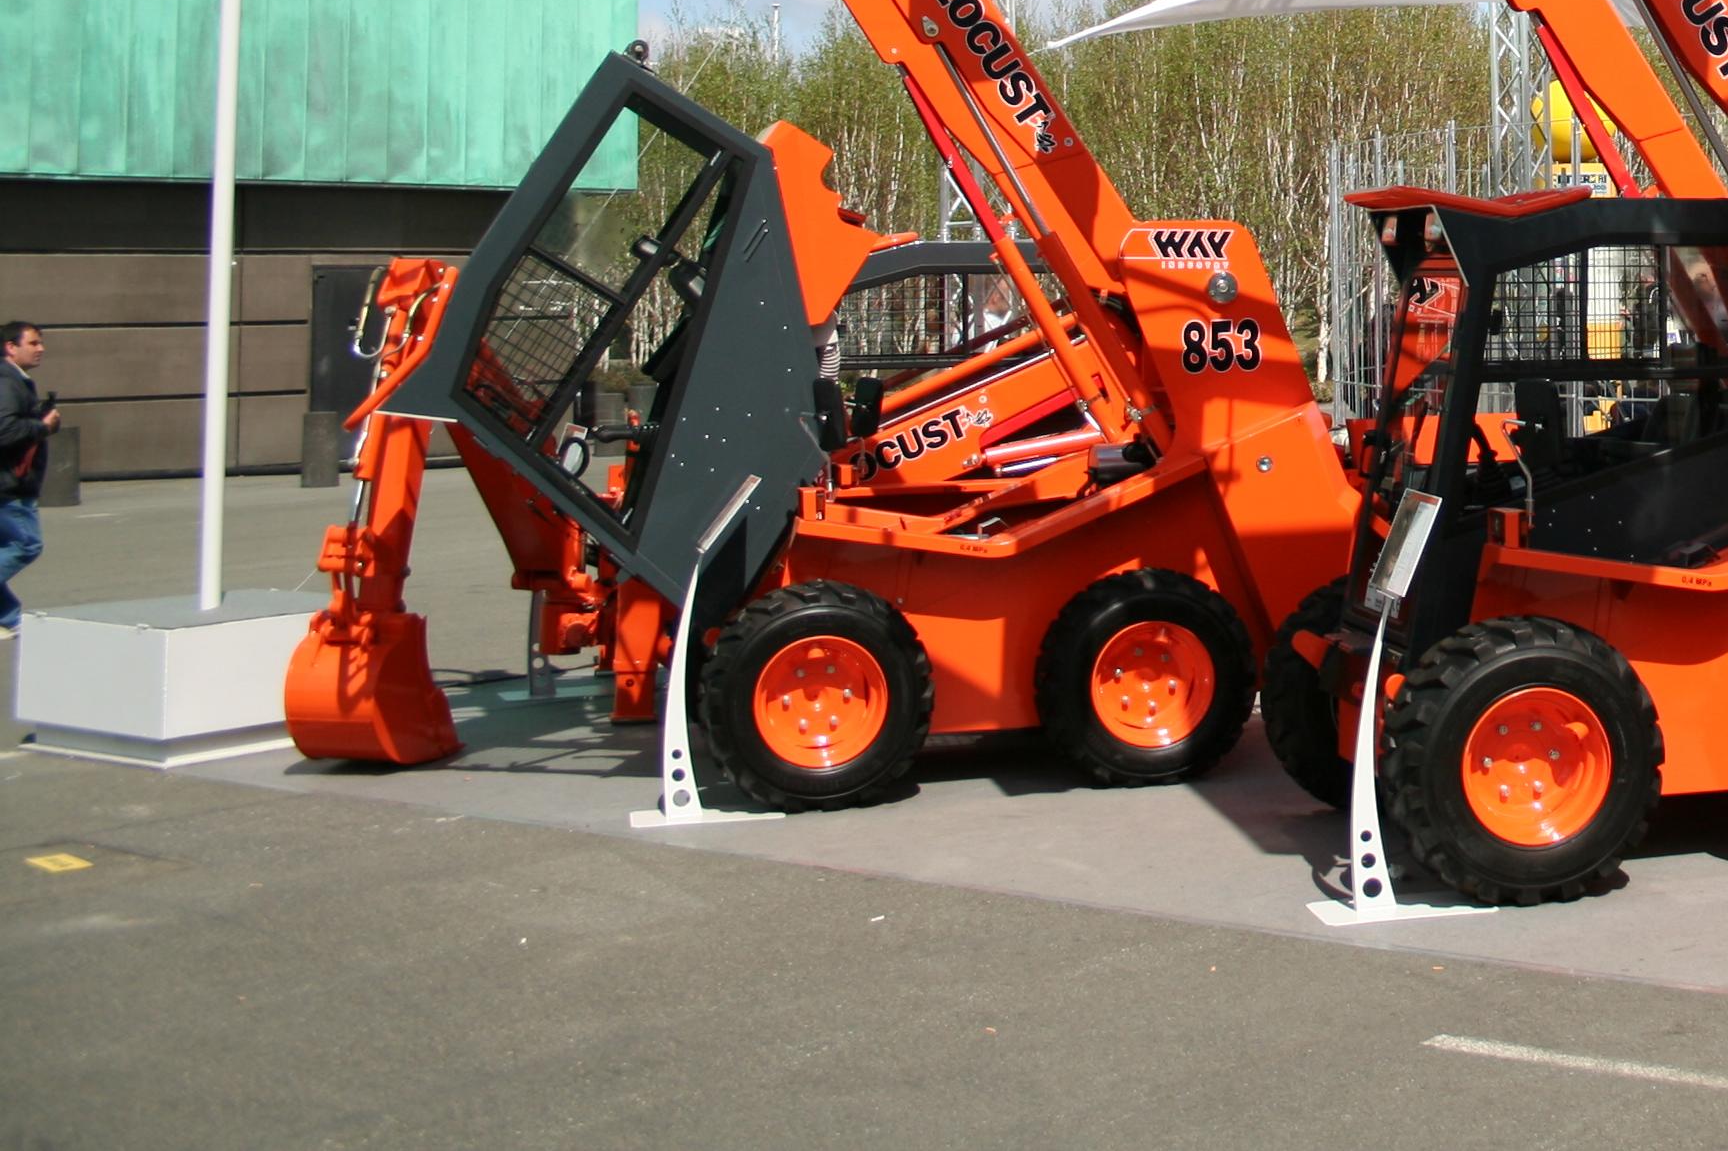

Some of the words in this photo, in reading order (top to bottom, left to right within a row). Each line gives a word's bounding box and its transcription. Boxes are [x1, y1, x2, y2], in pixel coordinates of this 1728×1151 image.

[1149, 229, 1234, 260] WAY
[1182, 318, 1262, 374] 853
[849, 405, 967, 482] OCUST
